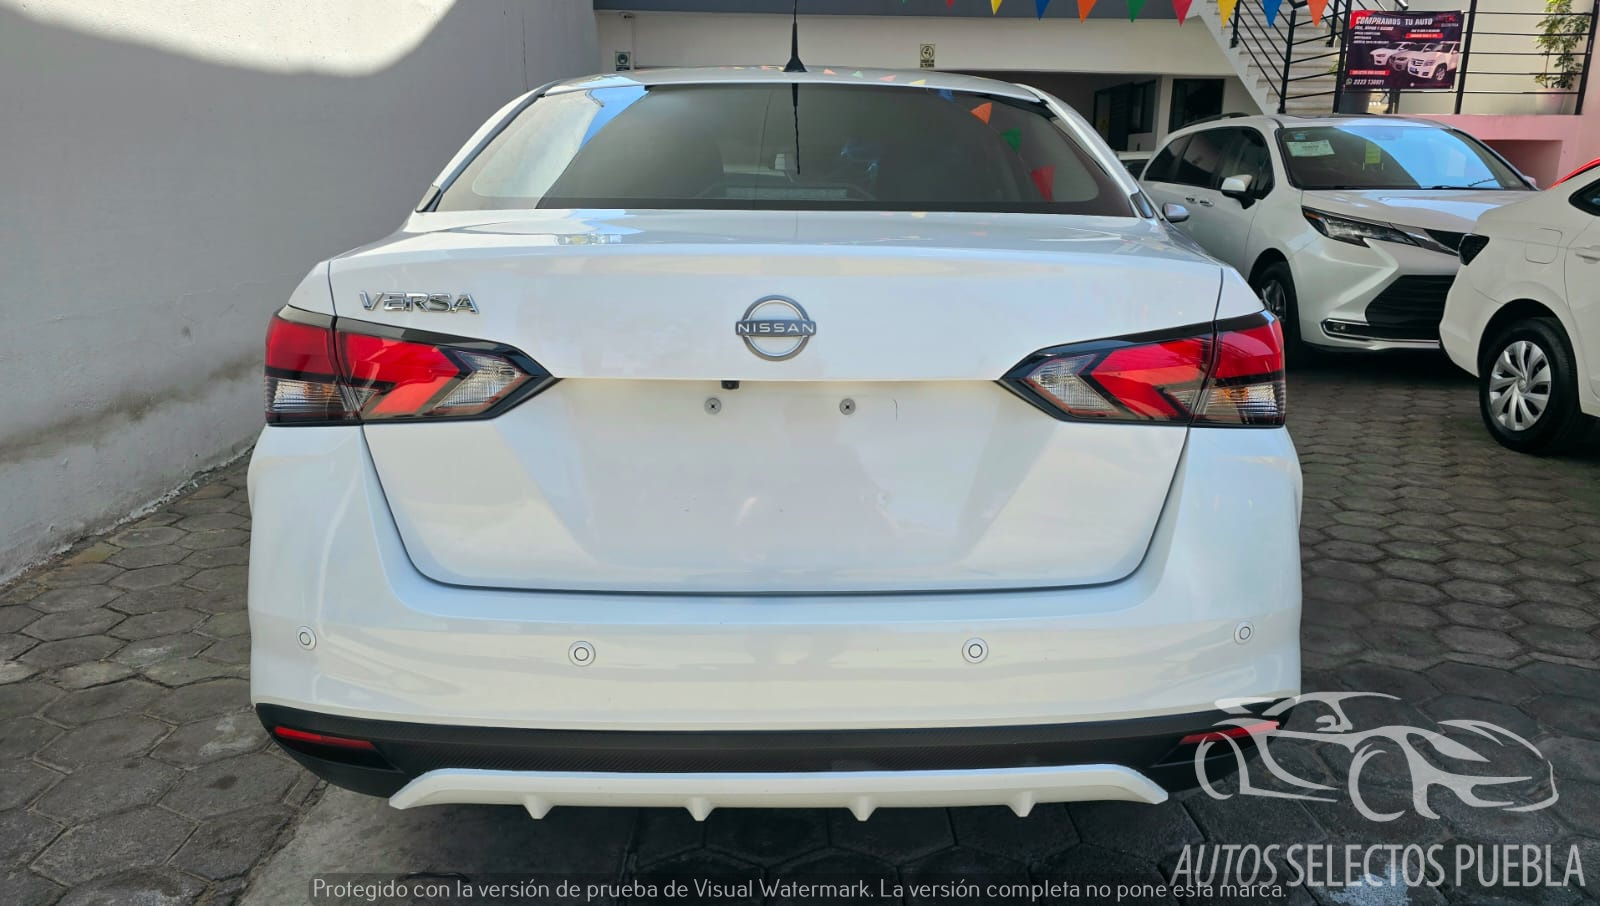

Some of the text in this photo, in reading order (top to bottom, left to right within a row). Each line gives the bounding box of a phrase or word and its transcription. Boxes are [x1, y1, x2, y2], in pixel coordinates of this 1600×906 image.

[1405, 18, 1414, 26] TU
[1415, 18, 1433, 26] AUTO
[359, 290, 481, 314] VERSA
[738, 322, 814, 334] NISSAN
